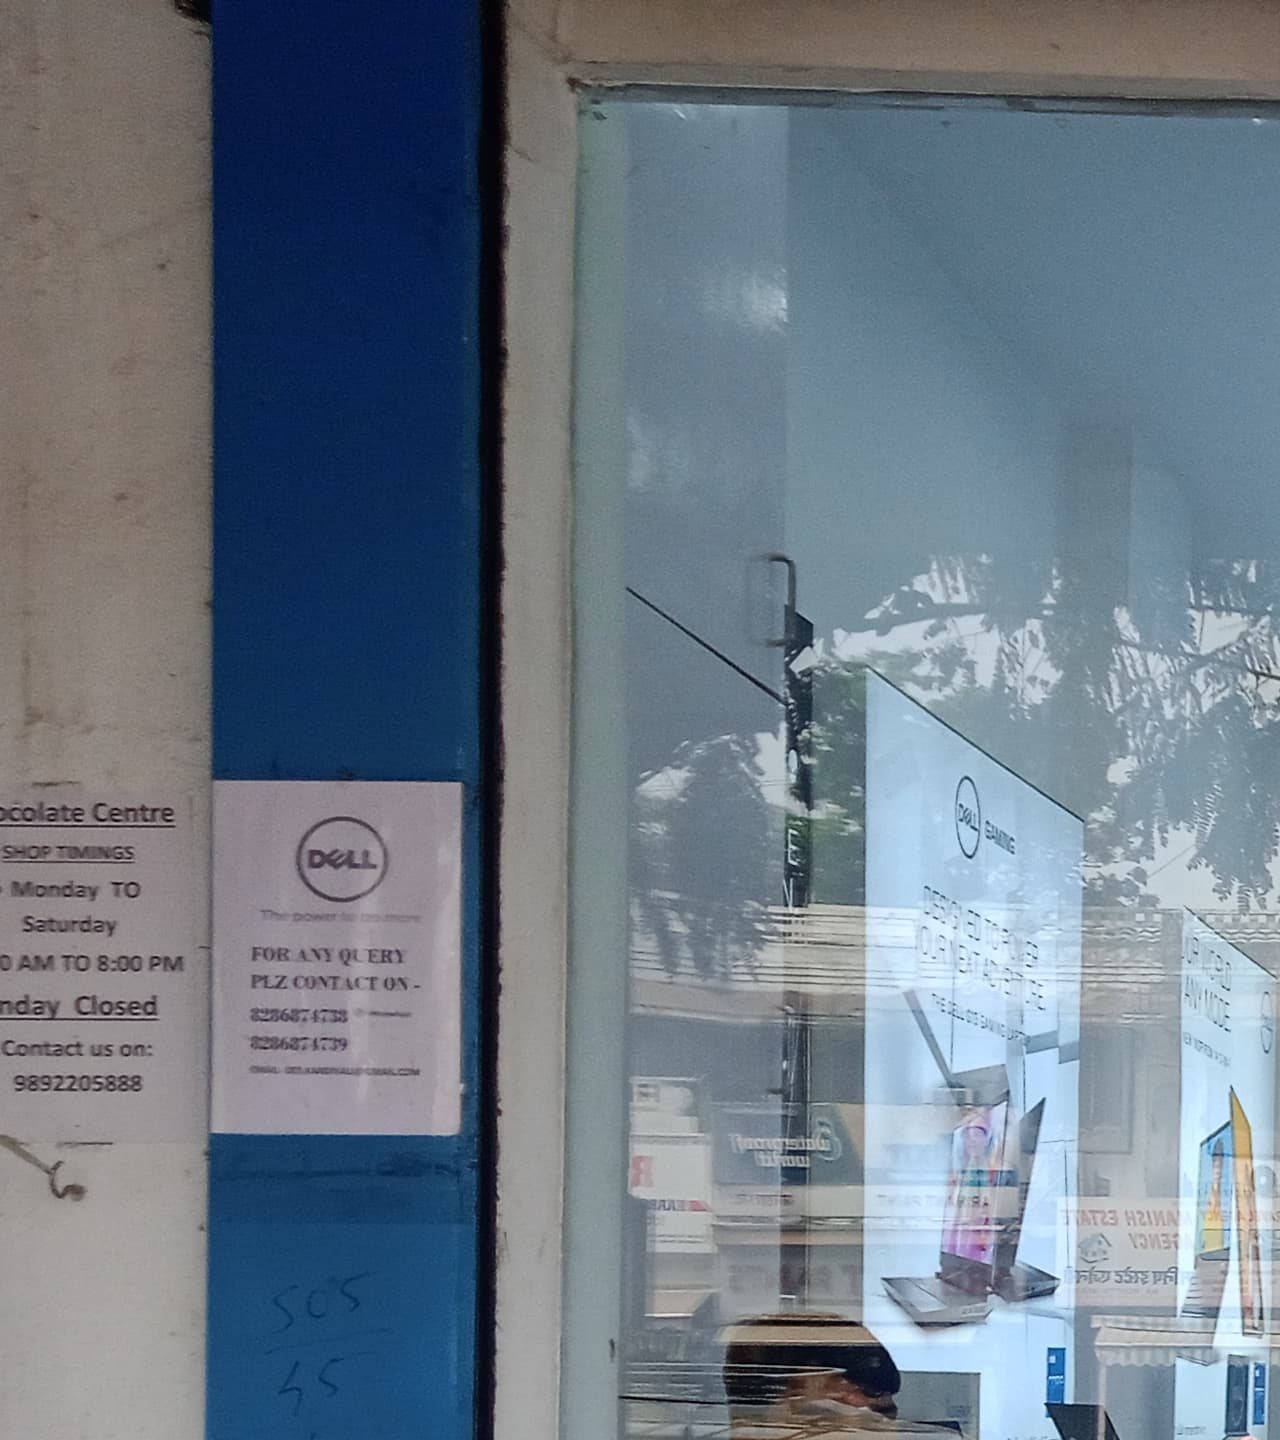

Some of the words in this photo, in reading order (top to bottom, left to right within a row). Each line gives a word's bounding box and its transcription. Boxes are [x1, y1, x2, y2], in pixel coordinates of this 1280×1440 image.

[93, 803, 175, 823] Centre
[3, 845, 51, 860] SHOP
[56, 846, 135, 860] TIMINGS
[308, 849, 377, 870] DELL
[10, 881, 98, 901] Monday
[111, 881, 141, 898] TO
[22, 915, 117, 937] Saturday
[18, 955, 54, 972] AM
[61, 955, 91, 972] TO
[98, 955, 143, 972] 8:00
[149, 956, 184, 972] PM
[251, 947, 290, 962] FOR
[297, 948, 332, 963] ANY
[340, 948, 406, 966] QUERY
[251, 975, 287, 989] PLZ
[293, 976, 378, 991] CONTACT
[384, 977, 408, 991] ON
[75, 994, 158, 1016] Closed
[2, 1039, 84, 1057] Contact
[90, 1043, 113, 1057] us
[120, 1043, 153, 1057] on:
[13, 1074, 143, 1092] 9892205888
